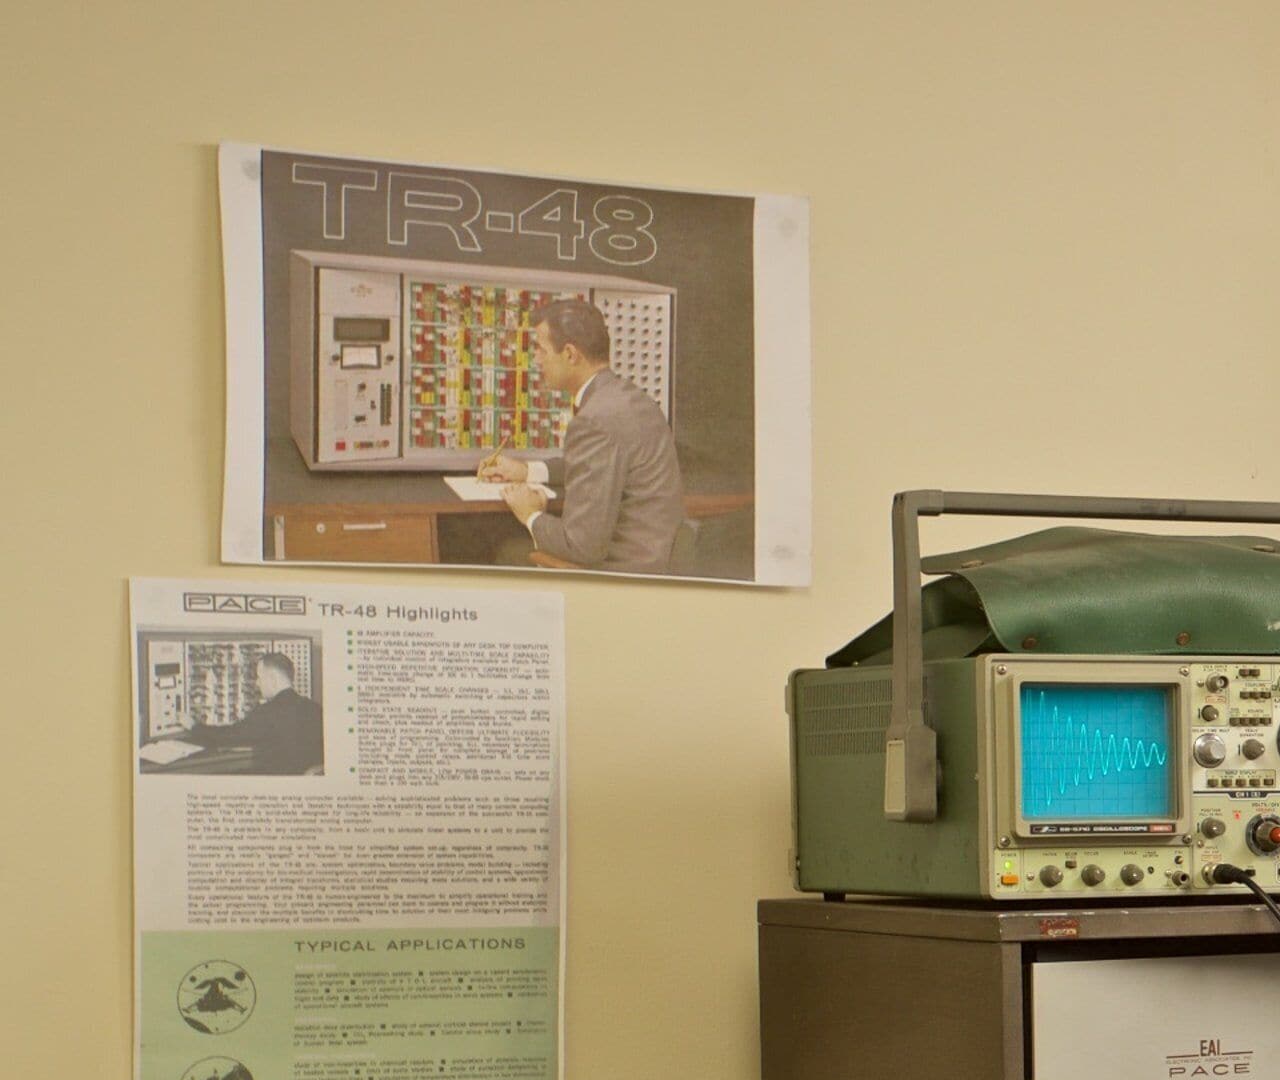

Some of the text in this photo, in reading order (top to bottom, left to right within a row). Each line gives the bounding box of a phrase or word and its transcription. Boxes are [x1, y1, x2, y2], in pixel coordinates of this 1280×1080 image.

[292, 162, 657, 266] TR-48
[186, 593, 478, 622] PACE TR-48 Highlights
[294, 936, 526, 952] TYPICAL APPLICATIONS
[1200, 1039, 1220, 1056] EAI
[1169, 1062, 1250, 1078] PACE
